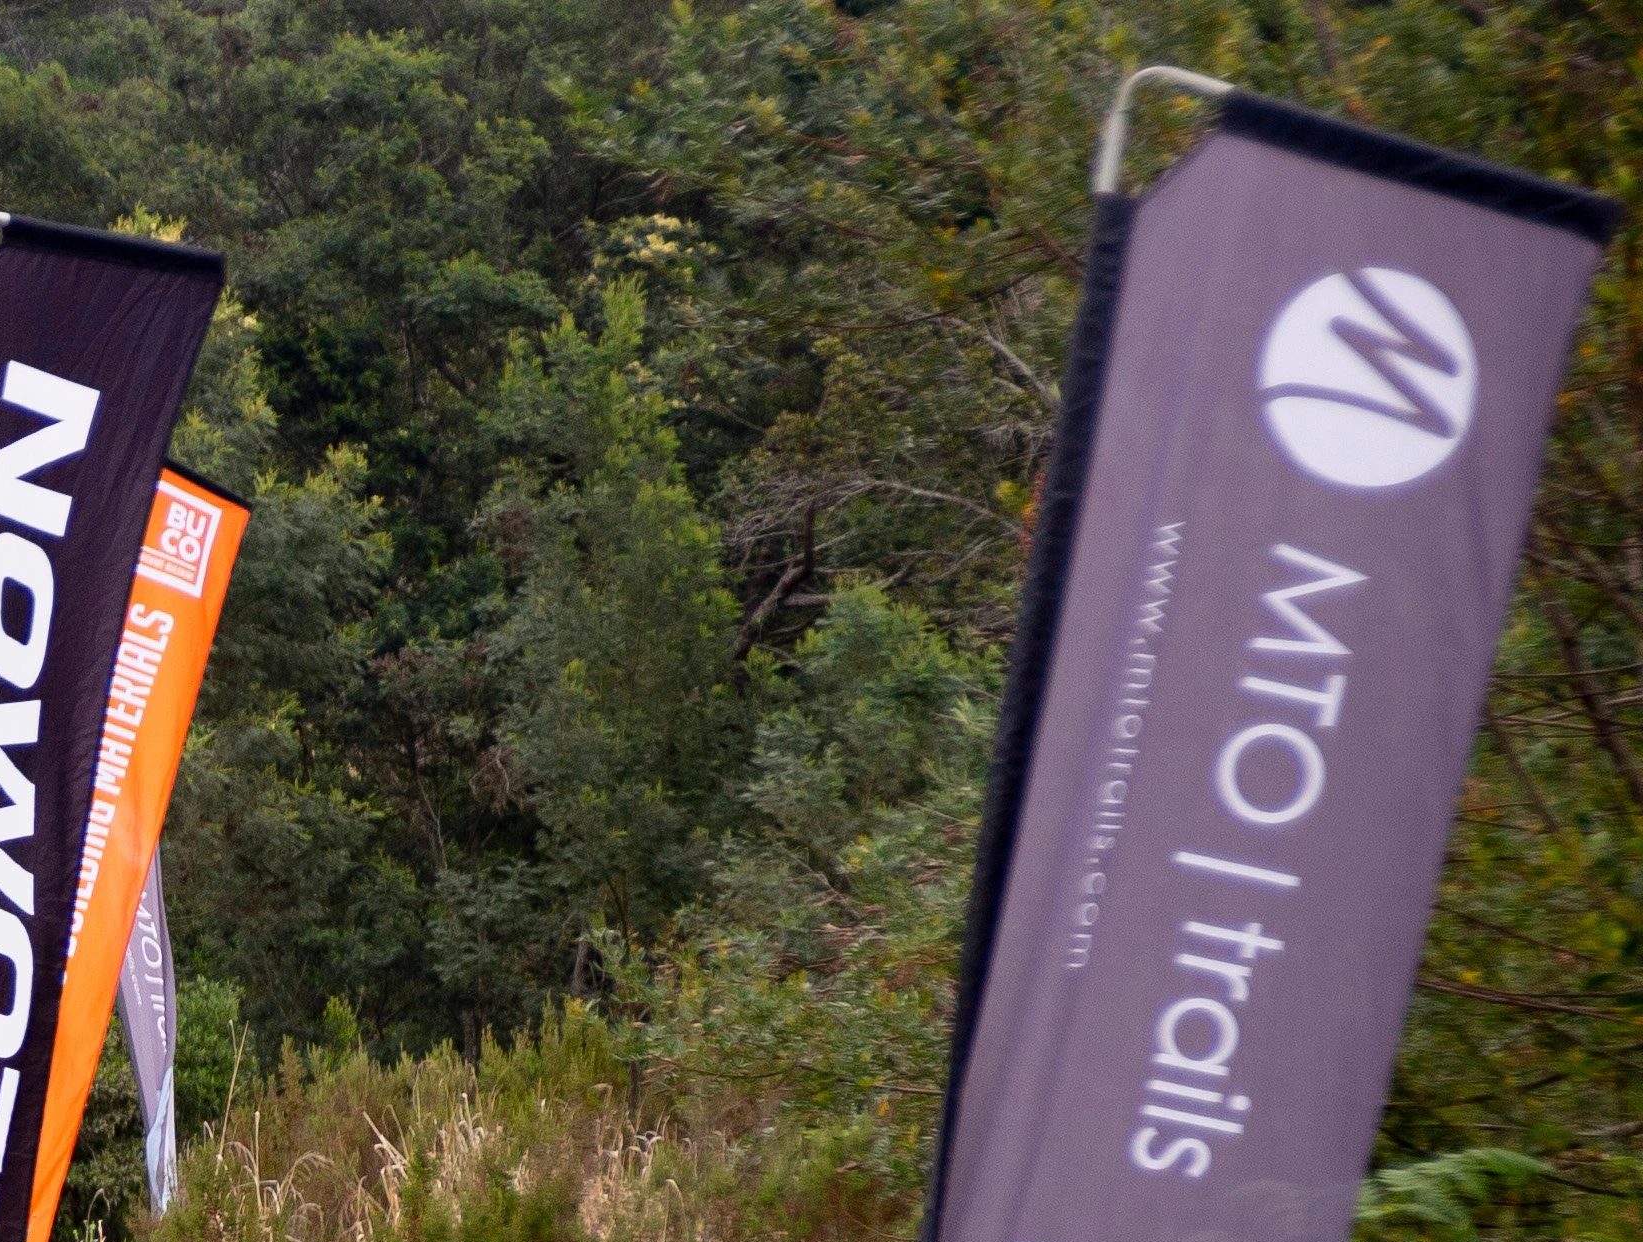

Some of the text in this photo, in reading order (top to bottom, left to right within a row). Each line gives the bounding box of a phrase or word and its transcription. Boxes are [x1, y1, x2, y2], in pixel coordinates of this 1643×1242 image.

[93, 603, 174, 796] MATERIALS
[1065, 520, 1186, 969] www.mtotrails.com
[1218, 543, 1368, 825] MTO
[1131, 920, 1284, 1178] trails
